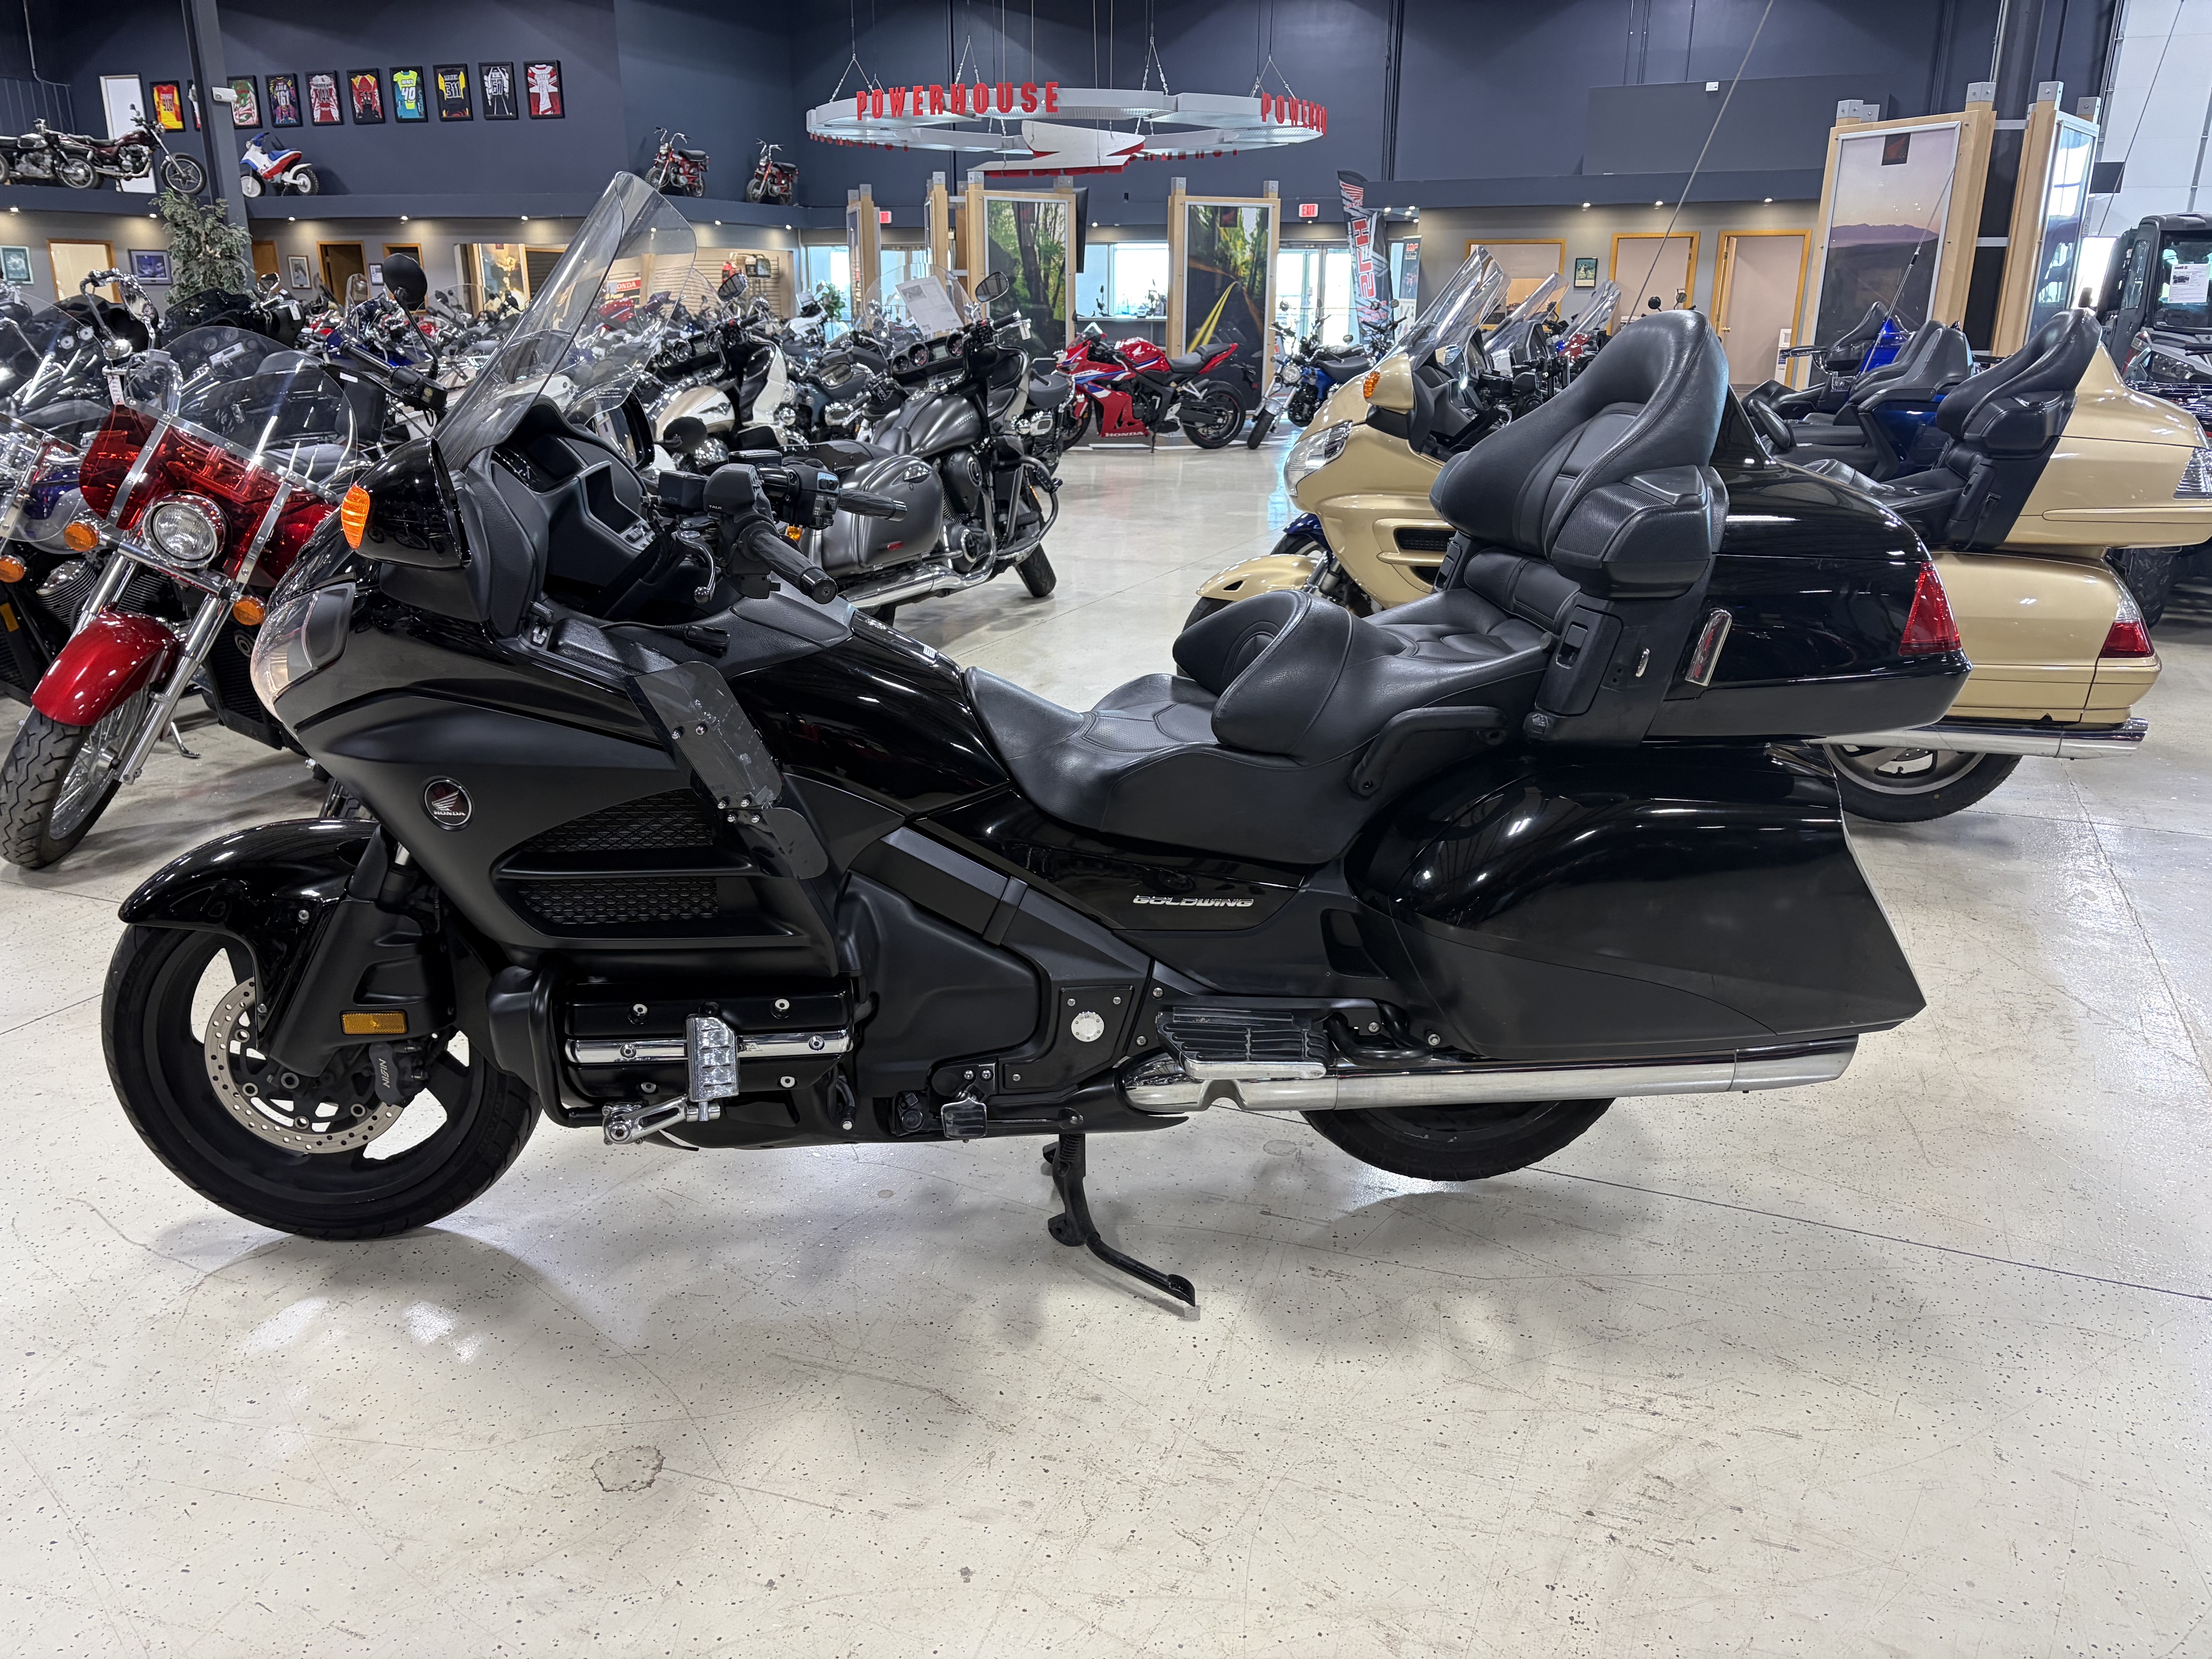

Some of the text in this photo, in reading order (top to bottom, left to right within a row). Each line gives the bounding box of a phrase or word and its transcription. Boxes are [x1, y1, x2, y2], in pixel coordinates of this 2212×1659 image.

[276, 90, 290, 106] 161
[401, 86, 416, 101] 40
[856, 81, 1058, 121] POWERHOUSE
[617, 281, 636, 290] ONDA
[1133, 895, 1254, 907] GOLDWING
[378, 1058, 390, 1088] NISSIN
